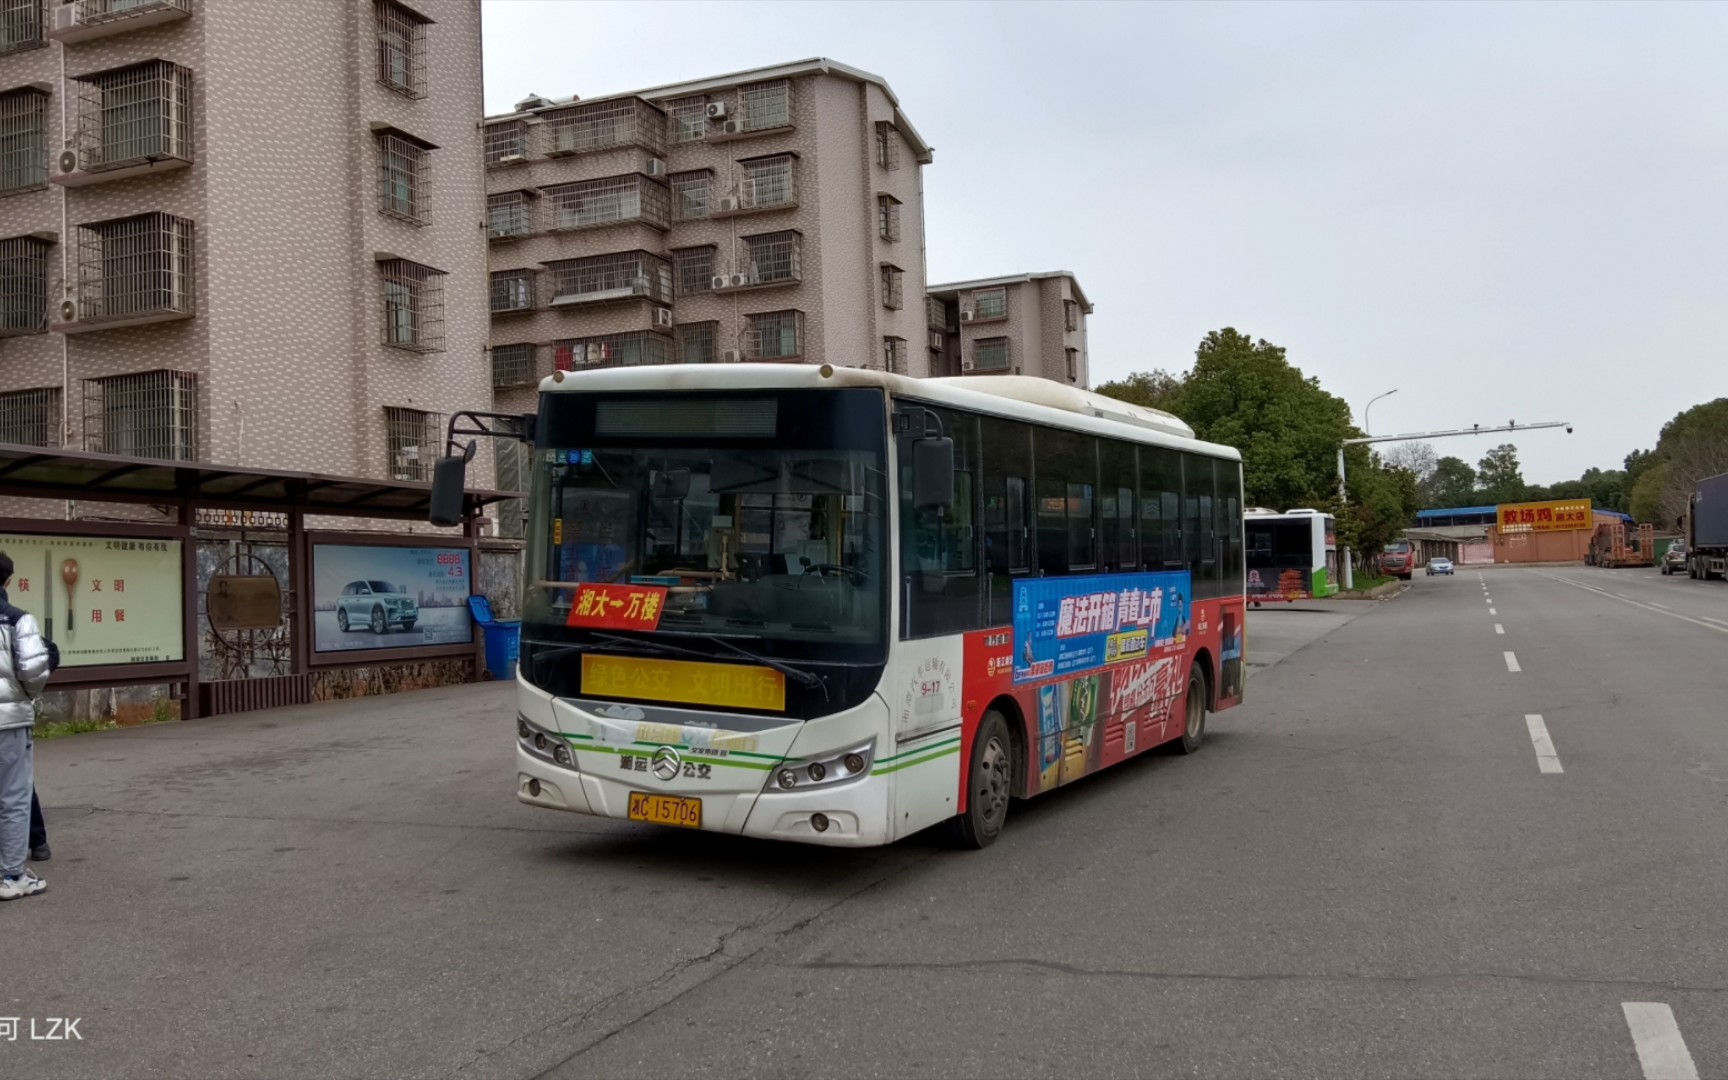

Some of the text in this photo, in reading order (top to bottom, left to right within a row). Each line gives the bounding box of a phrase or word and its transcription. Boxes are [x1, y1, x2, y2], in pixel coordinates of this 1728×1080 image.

[105, 541, 136, 551] 文明健康
[138, 542, 168, 552] 有你有我
[91, 579, 125, 592] 文明
[575, 588, 661, 621] 湘大 万楼
[91, 609, 125, 623] 用餐
[589, 662, 777, 702] 绿色公交 文明出行
[921, 681, 941, 696] 9-17
[683, 761, 712, 779] 公交
